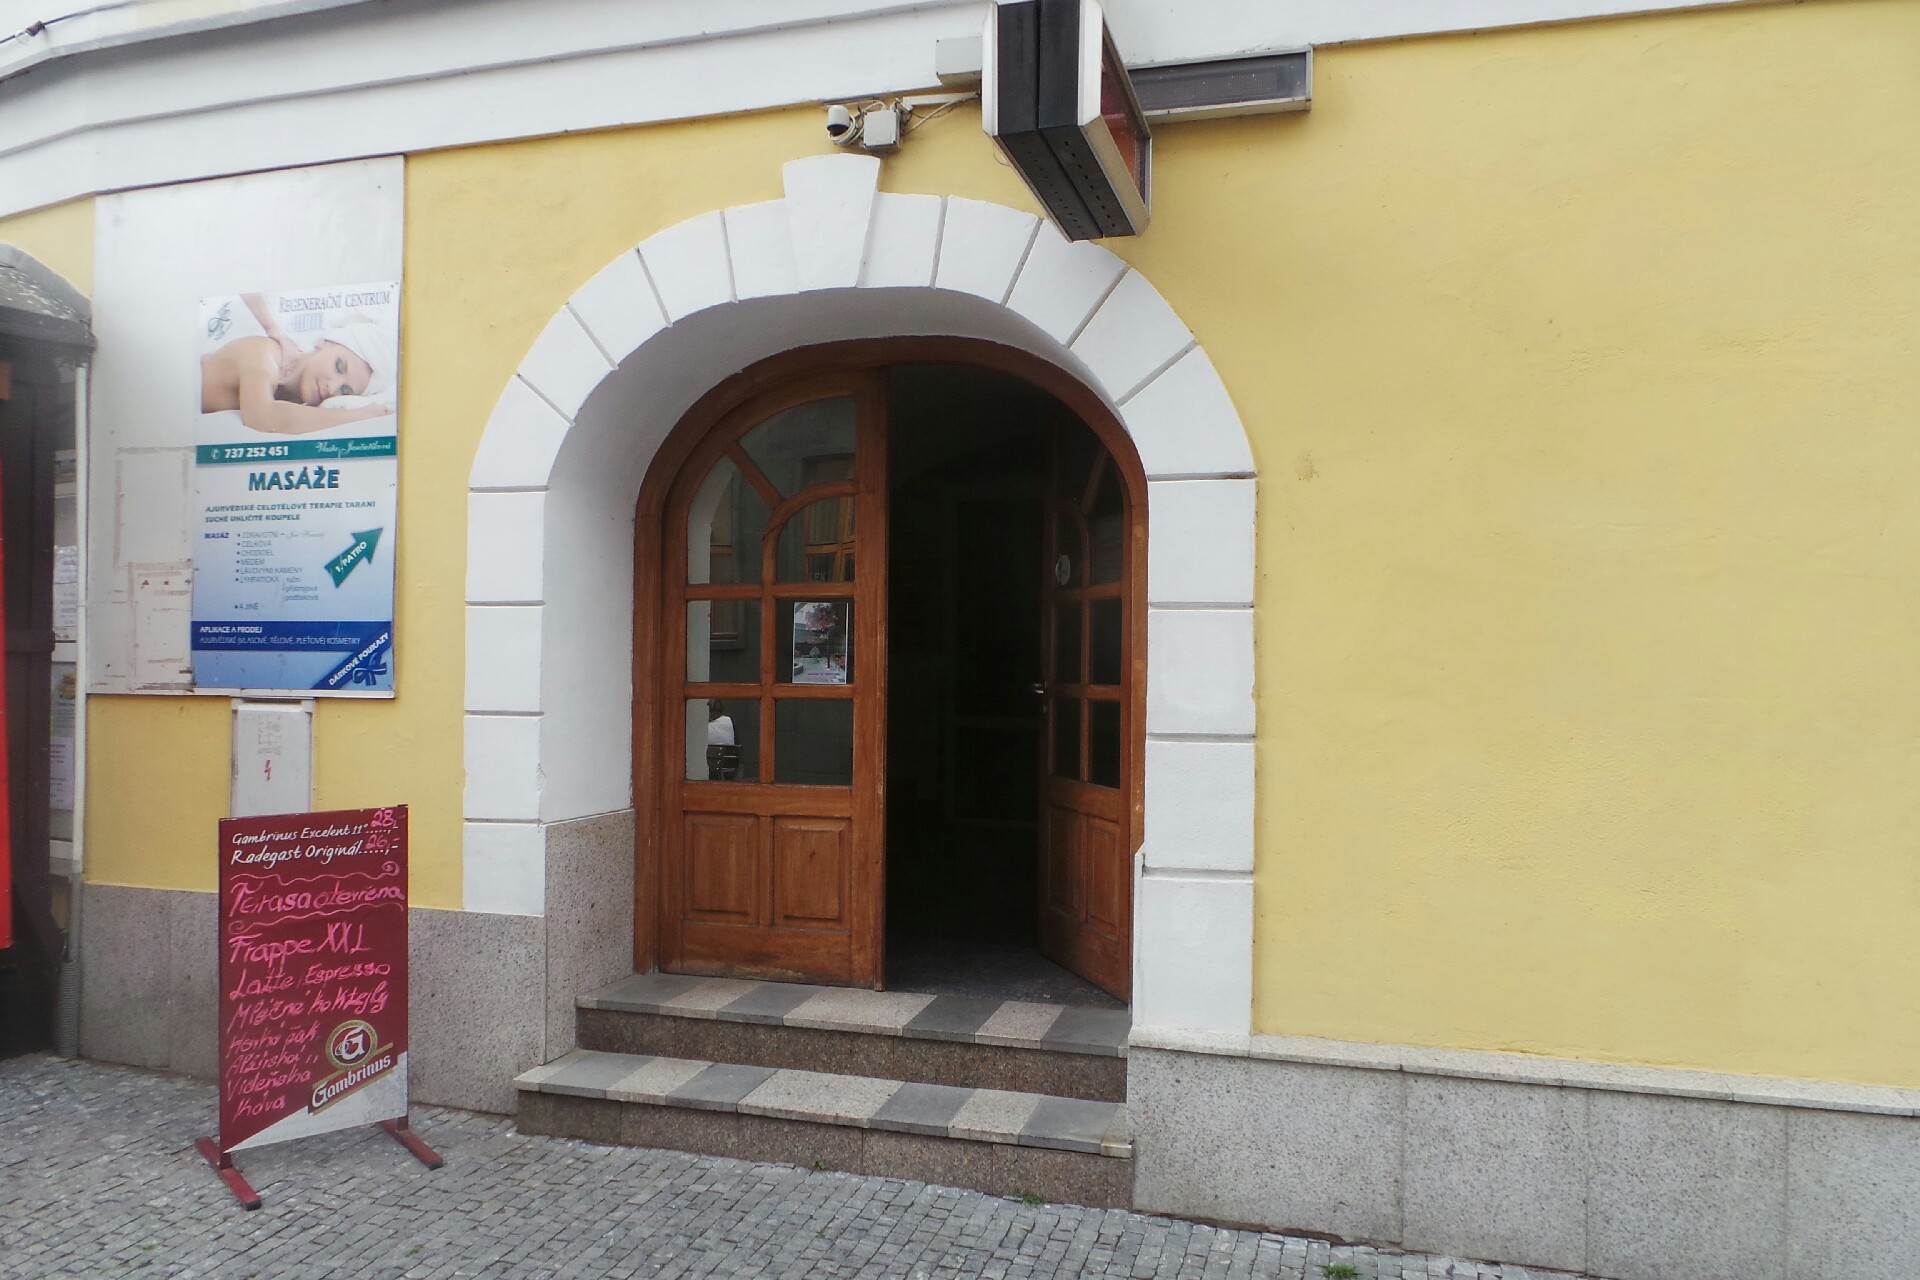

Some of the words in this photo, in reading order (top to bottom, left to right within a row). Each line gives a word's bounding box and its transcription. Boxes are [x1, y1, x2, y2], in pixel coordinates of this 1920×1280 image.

[278, 291, 342, 313] REGENERAČNÍ
[345, 291, 391, 307] CENTRUM
[224, 447, 244, 458] 737
[246, 446, 266, 458] 252
[268, 445, 289, 457] 451
[248, 465, 340, 491] MASÁŽE
[264, 513, 301, 522] KOUPELE
[309, 501, 343, 510] TERAPIE
[342, 541, 367, 567] PATRO
[200, 626, 231, 634] APLIKACE
[237, 626, 263, 634] PRODEJ
[358, 632, 389, 661] POUKAZY
[232, 829, 298, 846] Gambrinus
[300, 826, 351, 840] Excelent
[231, 845, 303, 870] Radegast
[229, 881, 312, 918] Terasa
[316, 921, 371, 955] XXL
[311, 1054, 392, 1108] Gambrinus
